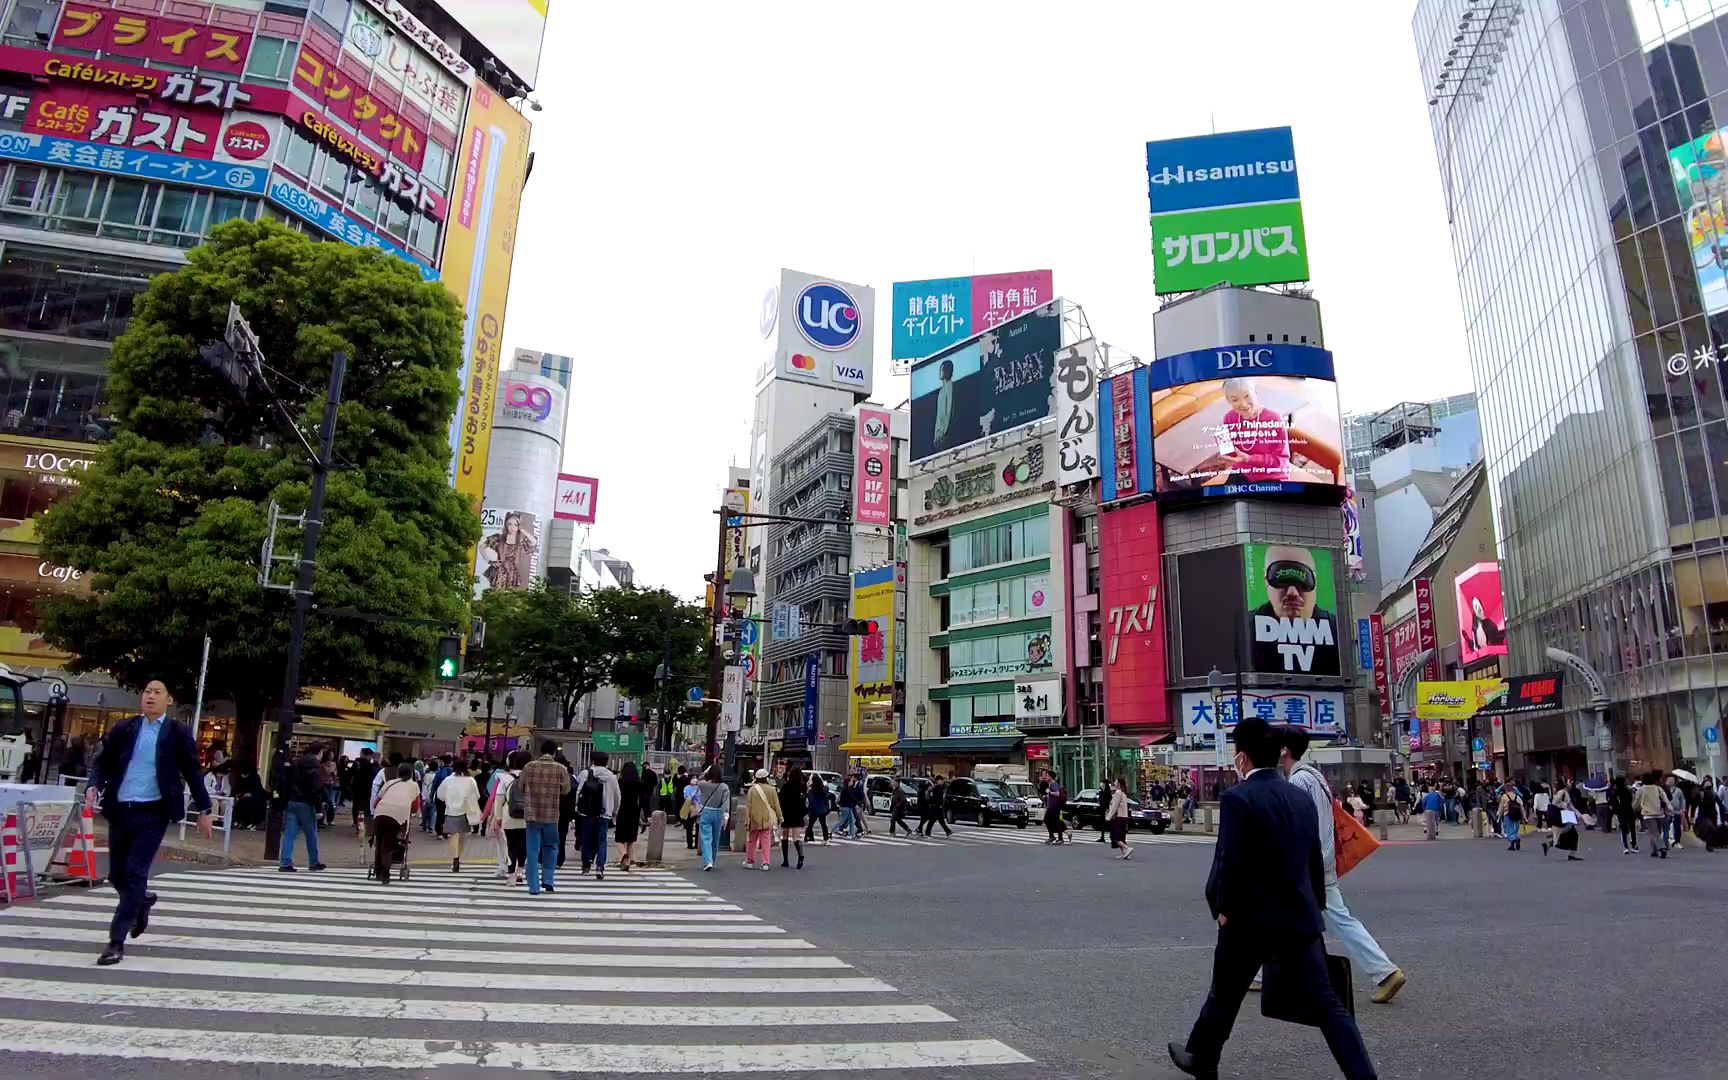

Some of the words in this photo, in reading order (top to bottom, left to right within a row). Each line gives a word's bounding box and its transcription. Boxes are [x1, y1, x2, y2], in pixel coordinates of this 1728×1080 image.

[63, 10, 241, 62] プライス
[161, 72, 251, 109] ガスト
[297, 53, 420, 154] コンタクト
[39, 100, 90, 123] Café
[36, 119, 85, 134] レストラン
[90, 106, 207, 152] ガスト
[228, 136, 265, 151] ガスト
[47, 141, 217, 181] 英会話イーオン
[229, 171, 253, 185] 6F
[1151, 159, 1294, 185] Hisamitsu
[277, 183, 321, 217] AEON
[379, 162, 435, 212] ガスト
[1161, 225, 1298, 268] サロンパス
[909, 292, 956, 316] 龍角散
[989, 286, 1038, 309] 龍角散
[902, 314, 964, 337] ダイレクト
[836, 365, 864, 380] VISA
[1216, 349, 1273, 370] DHC
[1058, 347, 1097, 476] もんじゃ
[561, 488, 586, 506] H&M
[1226, 484, 1248, 494] DHC
[1248, 483, 1283, 493] Channel
[1108, 584, 1157, 664] クスリ
[1254, 614, 1335, 646] DMM
[1418, 587, 1434, 645] カラオケ
[1394, 621, 1416, 648] カラオケ
[1277, 643, 1315, 672] TV
[1191, 698, 1336, 726] 大盛堂書店
